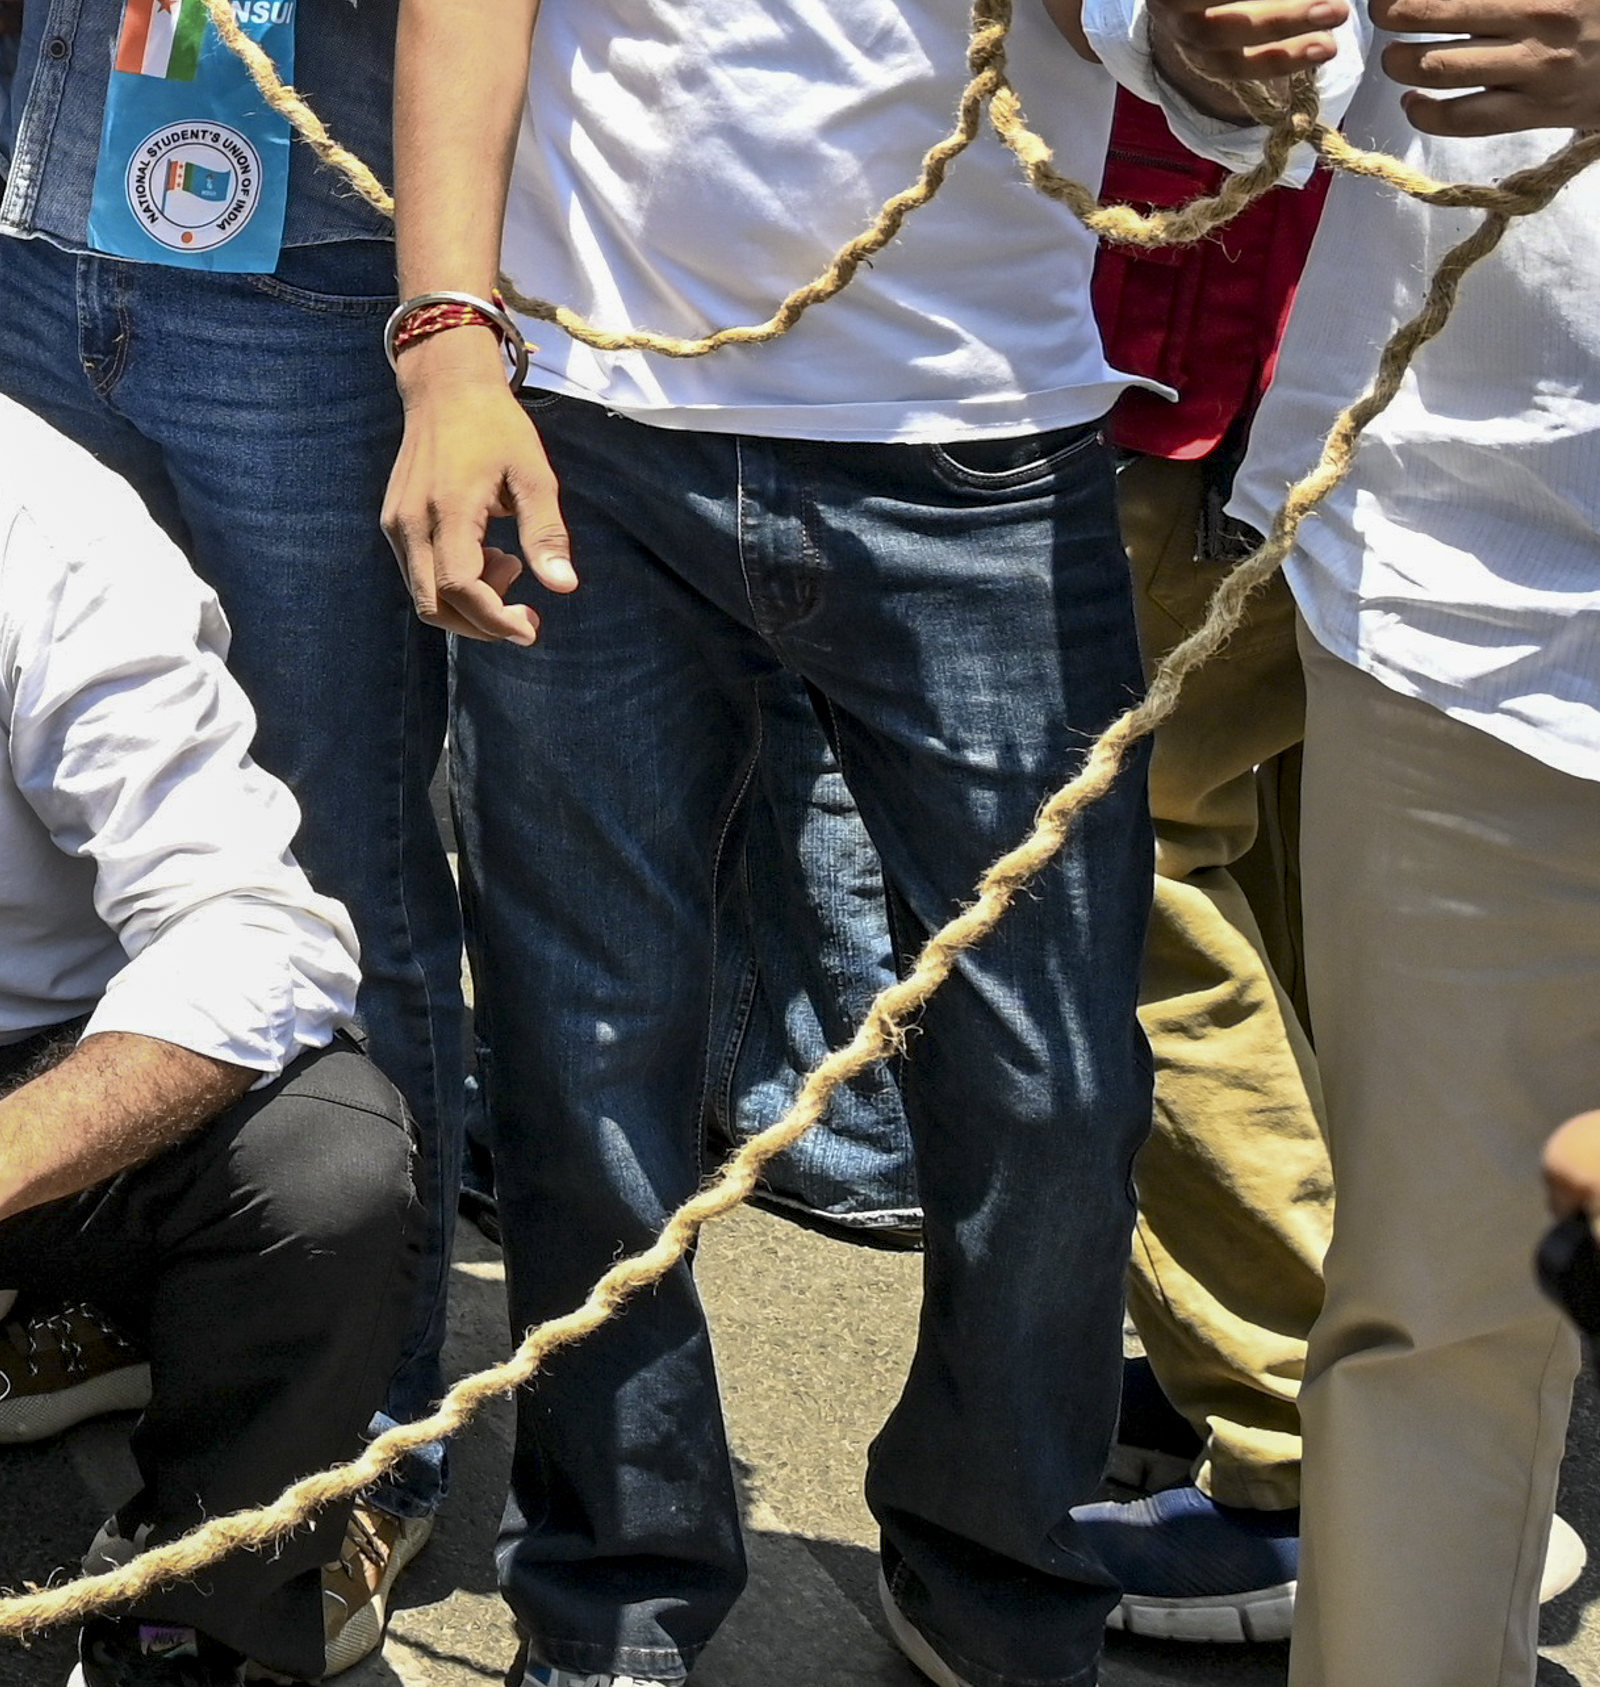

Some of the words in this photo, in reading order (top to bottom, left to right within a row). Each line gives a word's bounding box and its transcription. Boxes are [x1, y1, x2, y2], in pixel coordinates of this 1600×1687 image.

[147, 129, 220, 159] STUDENT'S
[222, 139, 252, 177] UNION
[134, 156, 158, 225] NATIONAL
[240, 177, 252, 196] OF
[216, 194, 247, 232] INDIA
